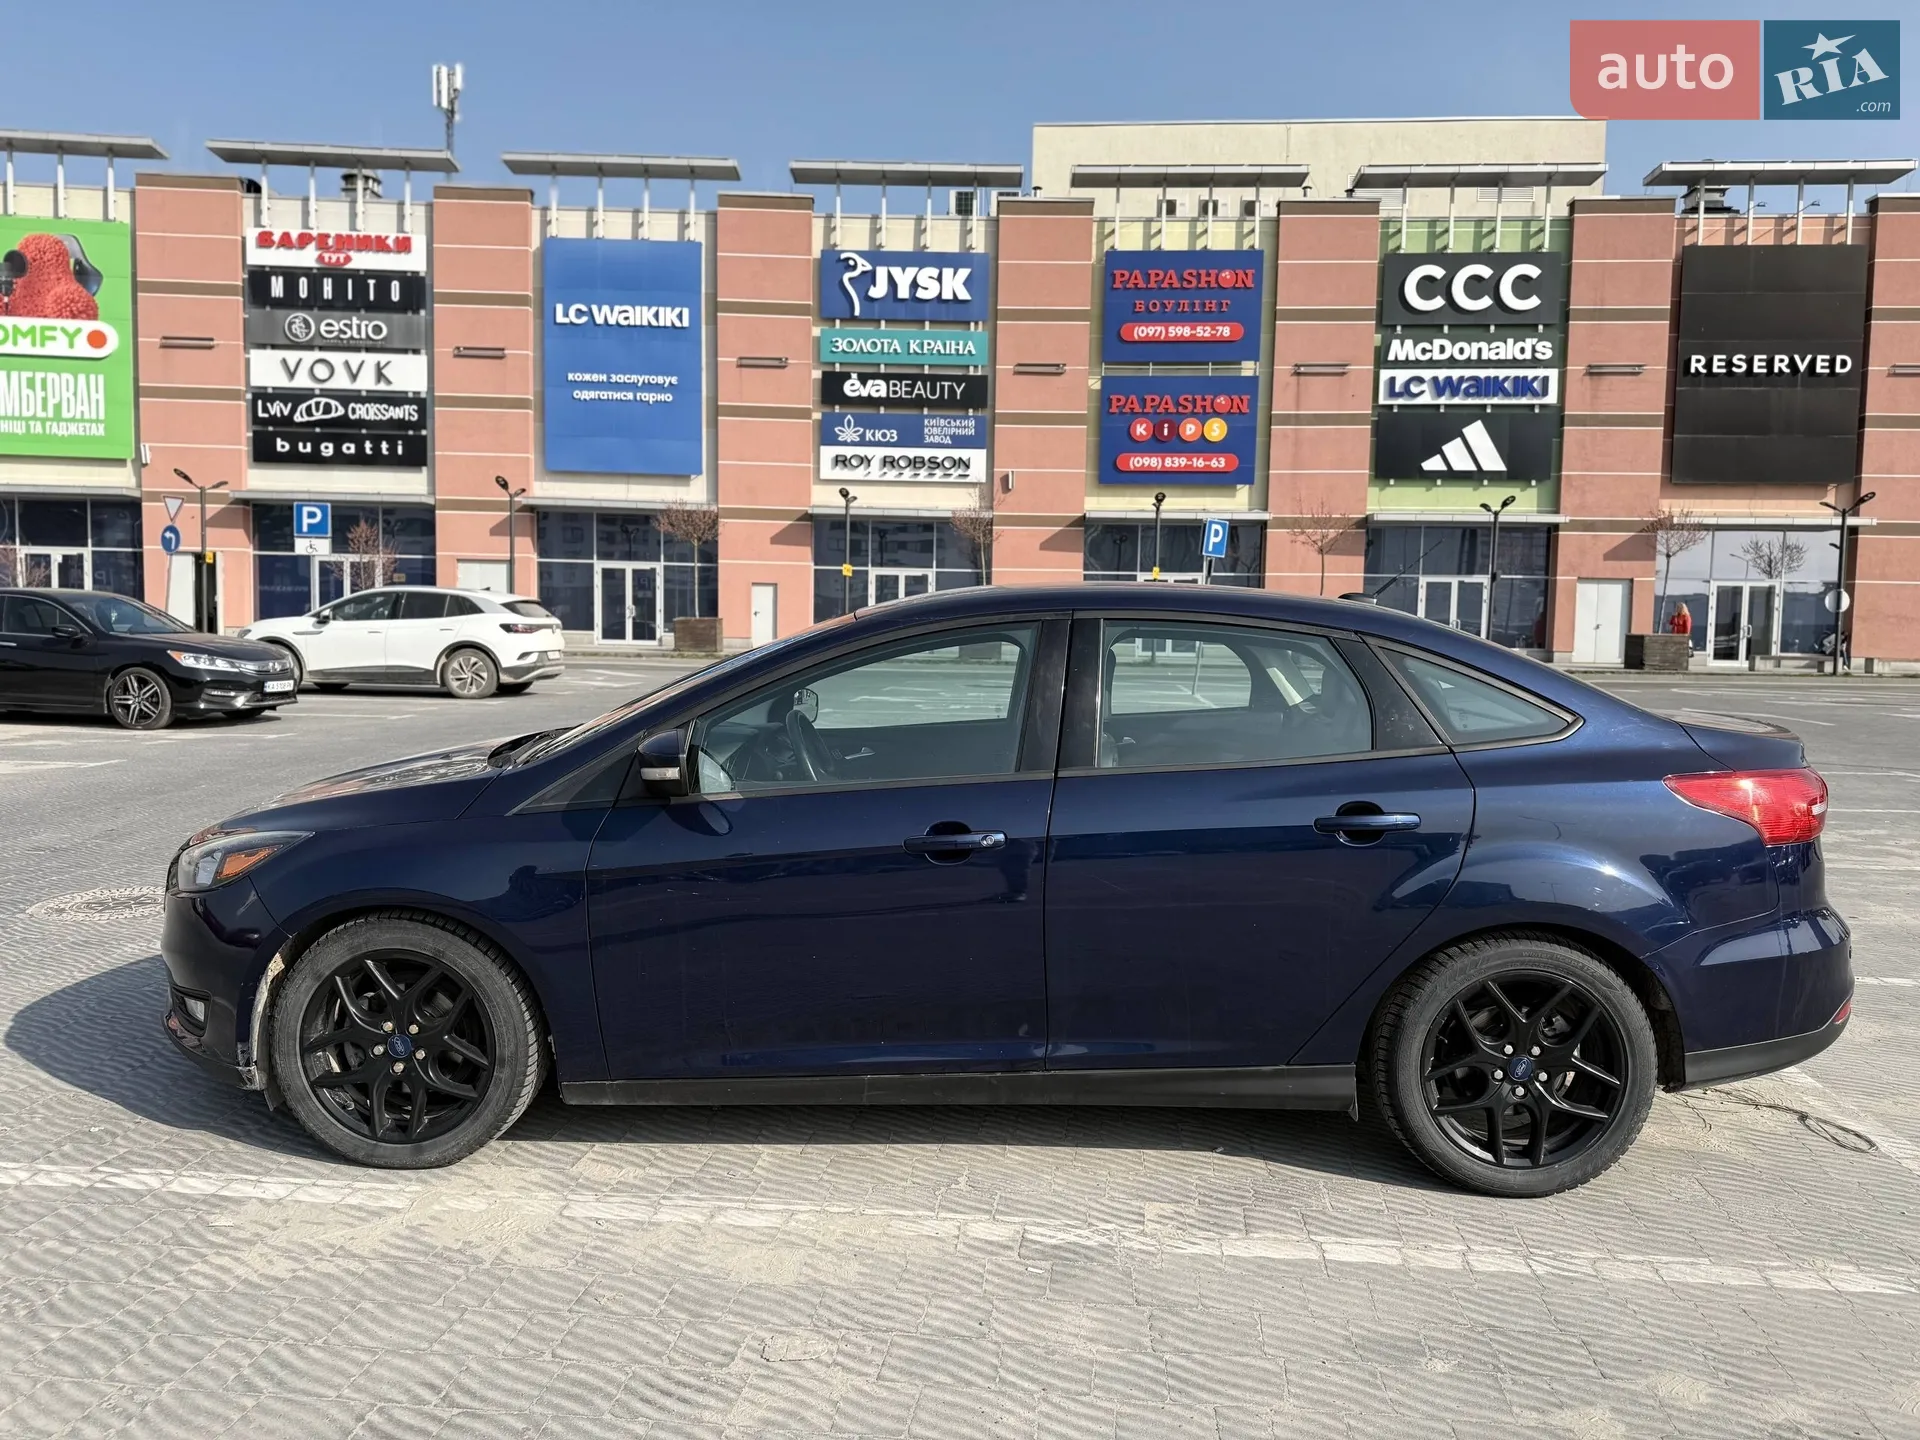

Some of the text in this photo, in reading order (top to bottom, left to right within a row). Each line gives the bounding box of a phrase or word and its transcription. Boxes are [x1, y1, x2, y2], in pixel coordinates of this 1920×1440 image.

[256, 230, 413, 254] ВАРЕНИКИ
[321, 252, 348, 263] ТУТ
[270, 275, 400, 302] MOHITO
[867, 266, 972, 300] JYSK
[1112, 269, 1256, 289] PAPASHON
[1404, 263, 1543, 311] CCC
[555, 303, 588, 324] LC
[1134, 300, 1231, 312] БОУЛІНГ
[319, 316, 388, 340] estro
[1133, 325, 1231, 339] (097) 598-52-78
[832, 337, 902, 354] ЗОЛОТА
[1387, 337, 1554, 361] McDonald's
[280, 357, 393, 386] VOVK
[1690, 354, 1852, 374] RESERVED
[567, 372, 678, 387] кожен заслуговує
[1387, 375, 1427, 399] LC
[573, 390, 673, 404] одягатися гарно
[1108, 394, 1251, 414] PAPASHON
[28, 420, 43, 435] ТА
[45, 421, 105, 438] ГАДЖЕТАХ
[924, 416, 976, 427] КИЇВСЬКИЙ
[924, 426, 975, 436] ЮВЕЛІРНИЙ
[865, 429, 898, 442] КЮЗ
[924, 434, 952, 445] ЗАВОД
[276, 437, 403, 457] bugatti
[834, 454, 971, 470] ROY ROBSON
[1129, 457, 1225, 470] (098) 839-16-63
[301, 506, 323, 533] P
[1208, 523, 1224, 552] P
